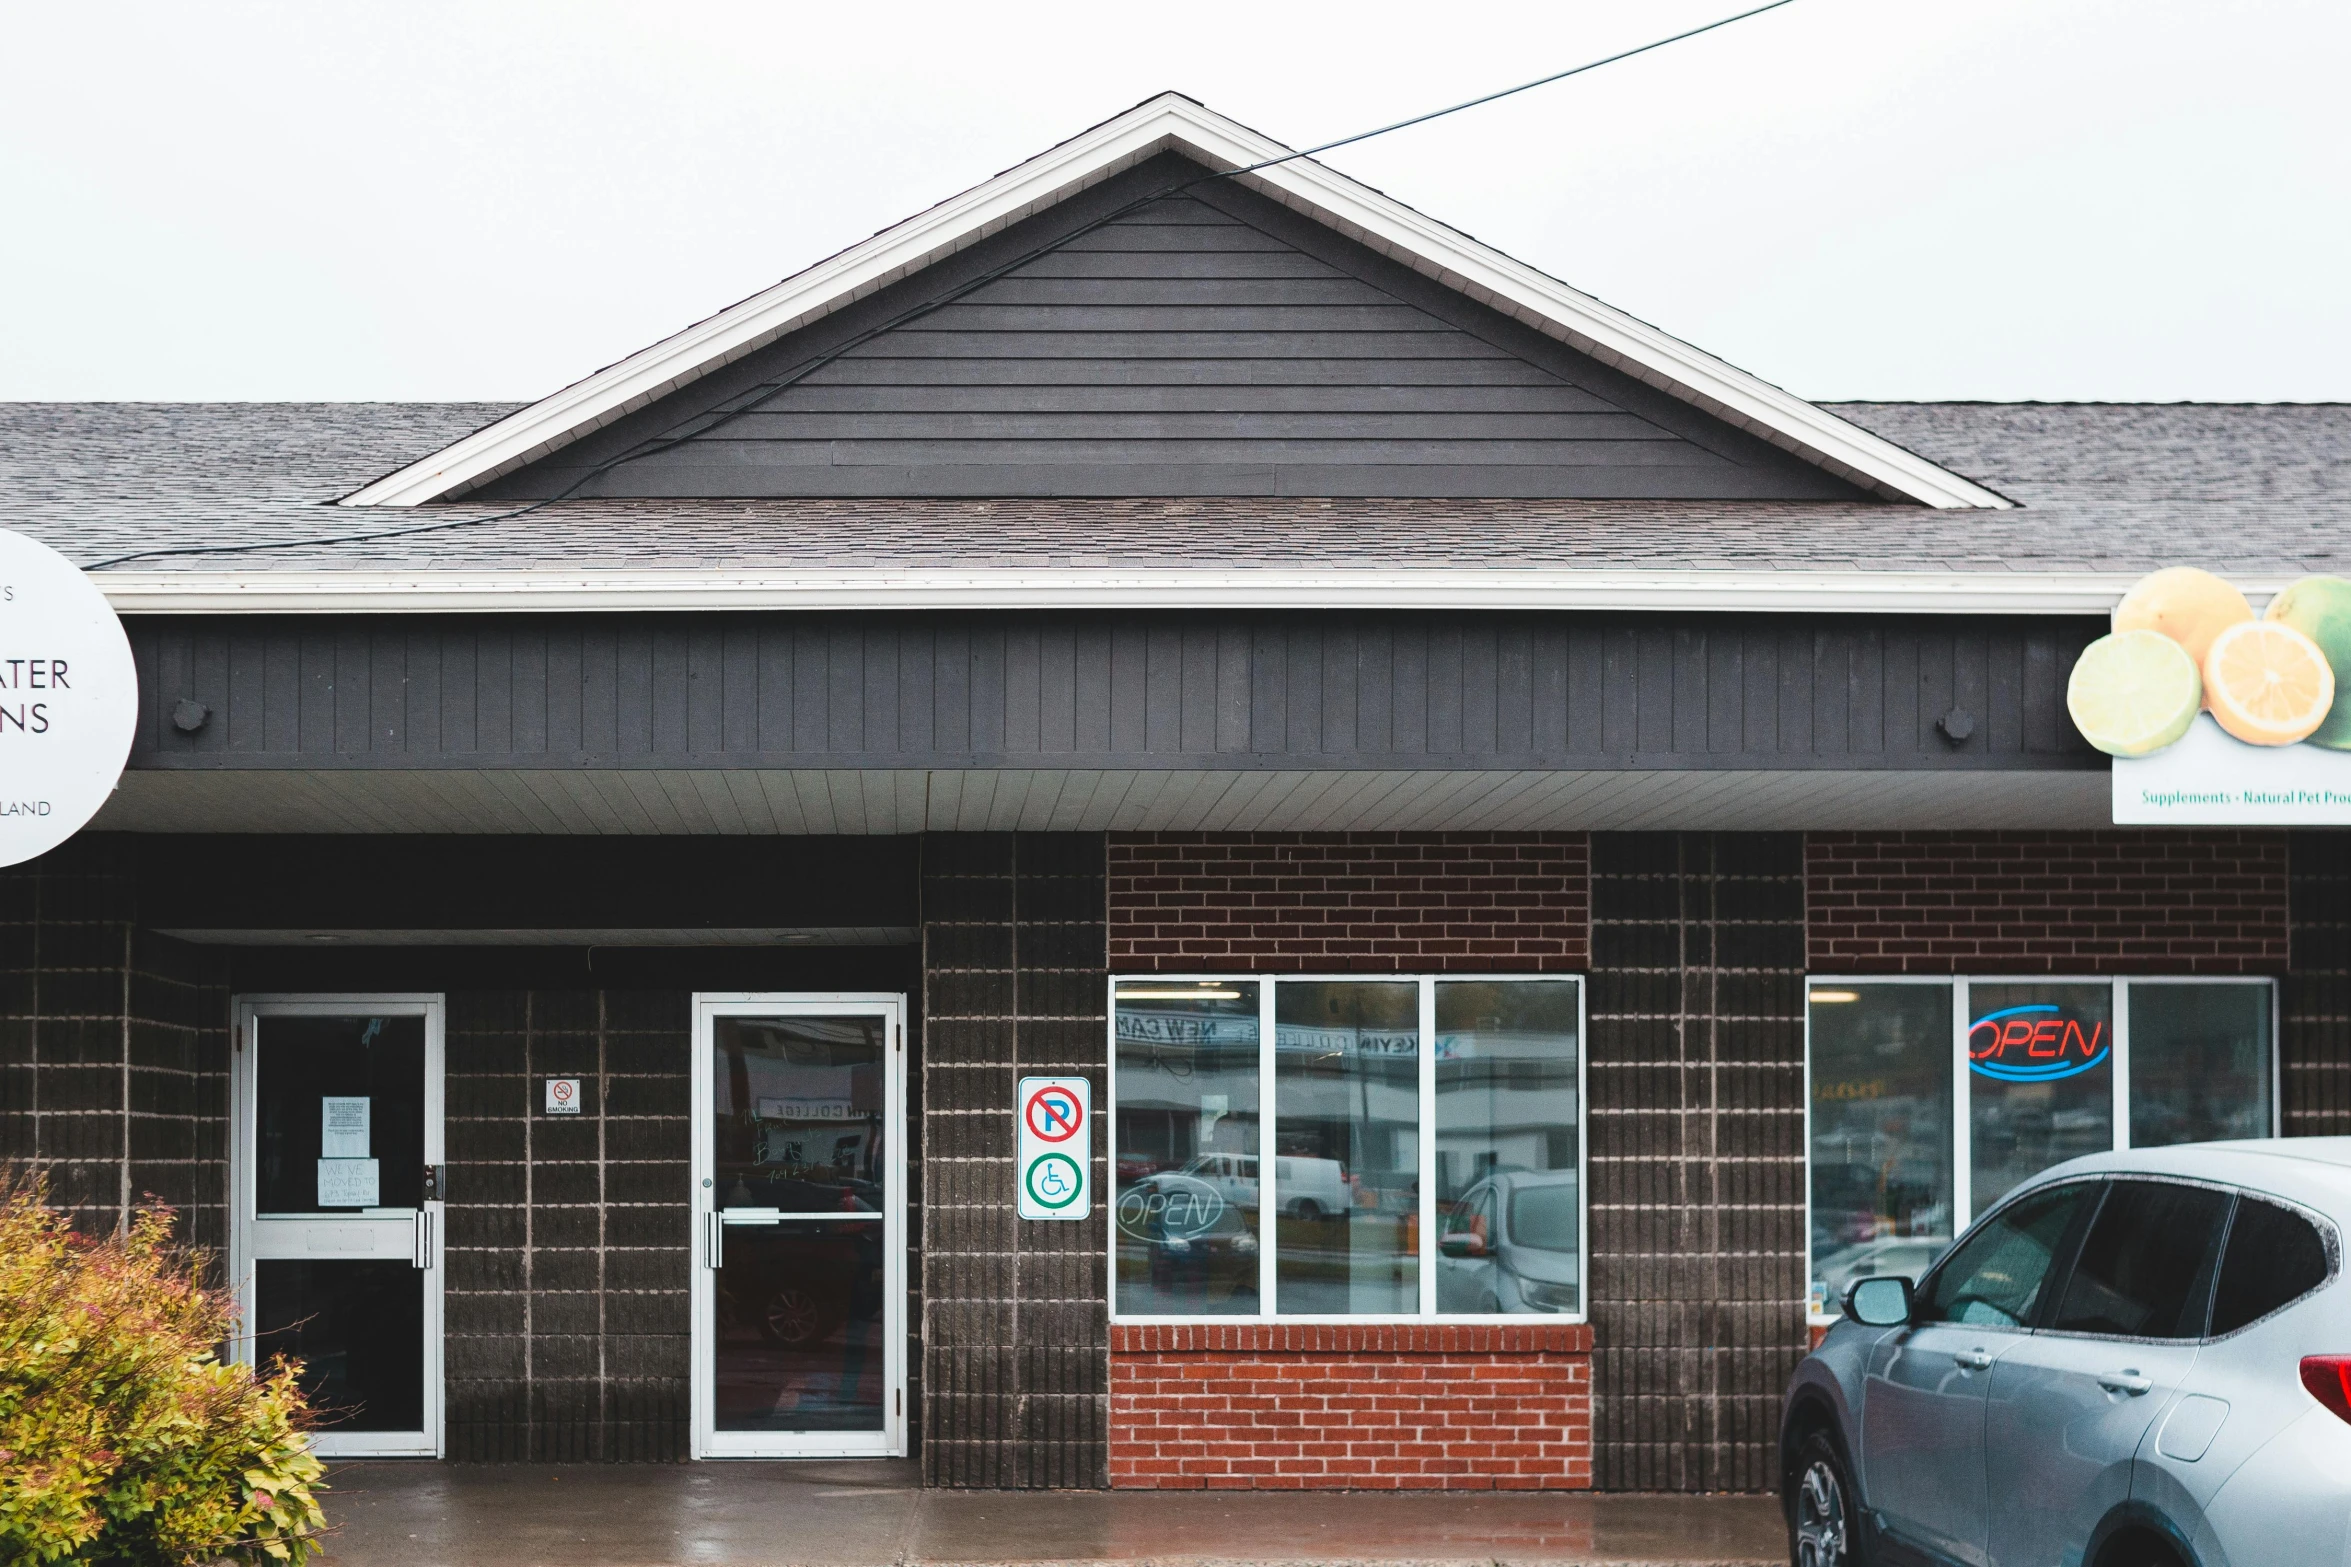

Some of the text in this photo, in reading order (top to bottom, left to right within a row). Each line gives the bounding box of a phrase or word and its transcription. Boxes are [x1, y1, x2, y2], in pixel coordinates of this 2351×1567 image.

[0, 659, 71, 689] TER
[2142, 789, 2231, 808] Supplements
[2244, 790, 2294, 804] Natural
[2298, 790, 2320, 804] Pet
[1968, 1020, 2102, 1058] OPEN
[1119, 1193, 1213, 1226] OPEN
